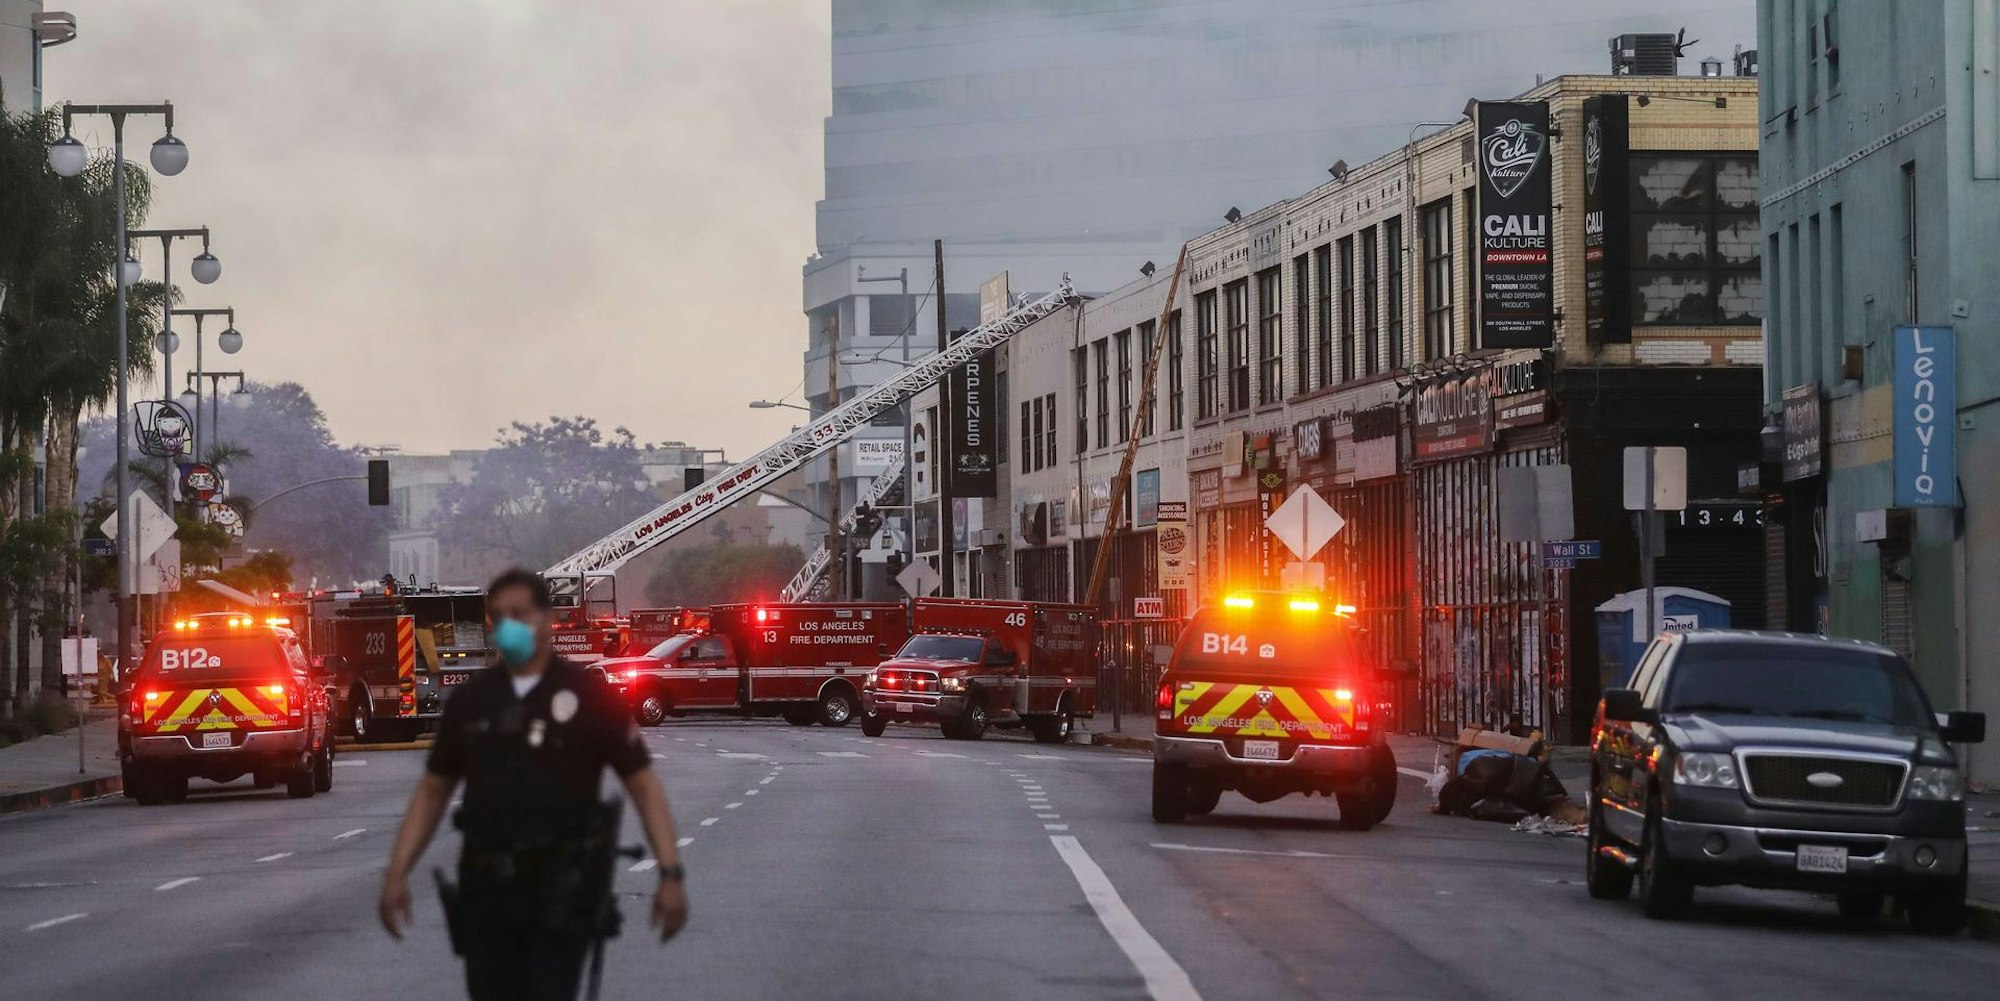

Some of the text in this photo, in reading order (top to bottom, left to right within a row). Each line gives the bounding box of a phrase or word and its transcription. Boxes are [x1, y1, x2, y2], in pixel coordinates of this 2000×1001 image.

[1488, 132, 1529, 166] Cali
[1484, 214, 1546, 236] CALI
[1586, 211, 1603, 235] CALI
[1484, 237, 1546, 248] KULTURE
[966, 359, 980, 446] RPENES
[1913, 328, 1934, 495] Lenovia
[814, 424, 833, 441] 33
[859, 443, 902, 452] RETAIL SPACE
[635, 464, 761, 540] LOS ANGELES City FIRE DEPT.
[1159, 504, 1185, 512] SMOKING
[1553, 544, 1591, 556] Wall St
[1136, 602, 1162, 614] ATM
[799, 622, 865, 630] LOS ANGELES
[1005, 613, 1026, 626] 46
[366, 632, 385, 655] 233
[763, 631, 777, 643] 13
[790, 635, 874, 644] FIRE DEPARTMENT
[1202, 632, 1248, 655] B14
[162, 648, 208, 670] B12
[170, 717, 200, 725] ANGELES
[235, 713, 278, 722] DEPARTMENT
[1184, 715, 1203, 725] LOS
[1208, 717, 1251, 729] ANGELES
[1280, 720, 1343, 733] DEPARTMENT
